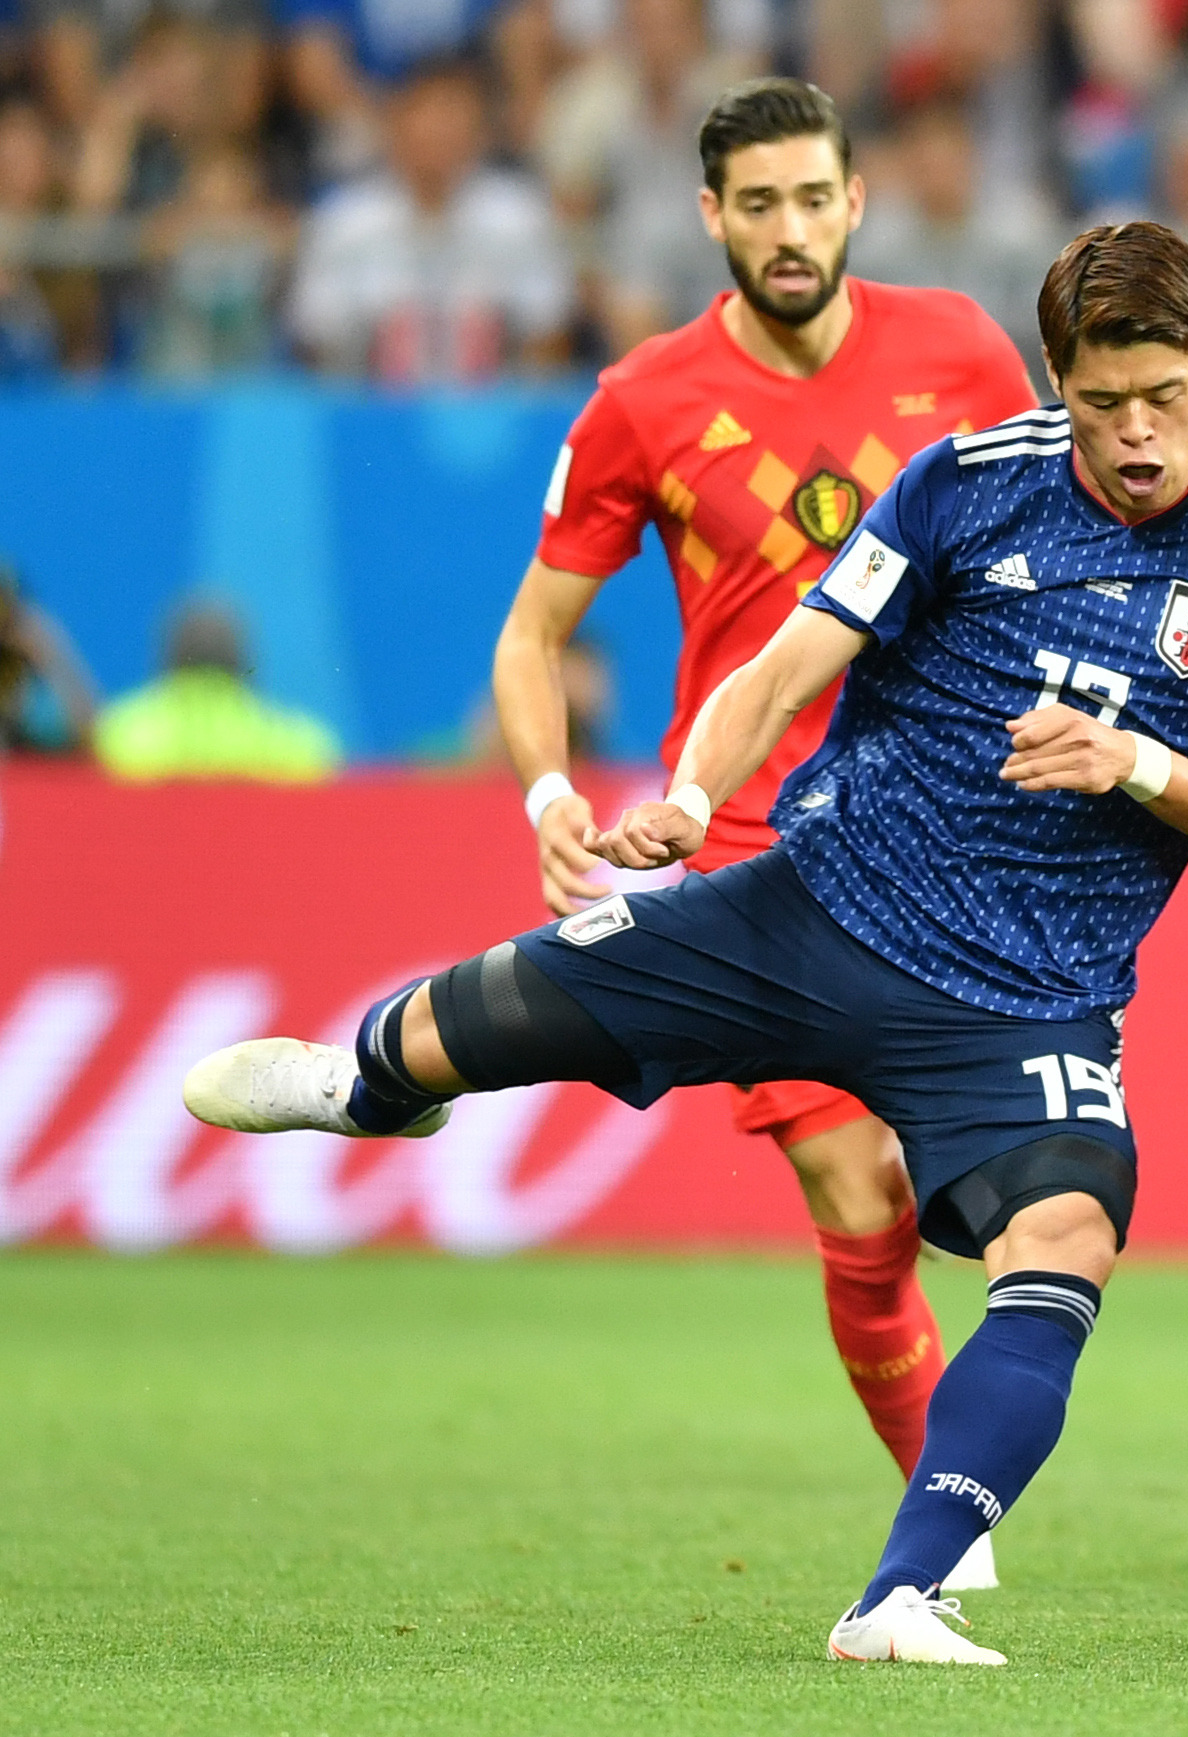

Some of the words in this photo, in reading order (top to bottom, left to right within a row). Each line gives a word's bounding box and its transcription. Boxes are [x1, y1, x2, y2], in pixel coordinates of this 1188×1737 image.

[984, 570, 1037, 591] adidas
[1021, 1052, 1127, 1130] 19
[925, 1472, 1004, 1529] JAPAN
